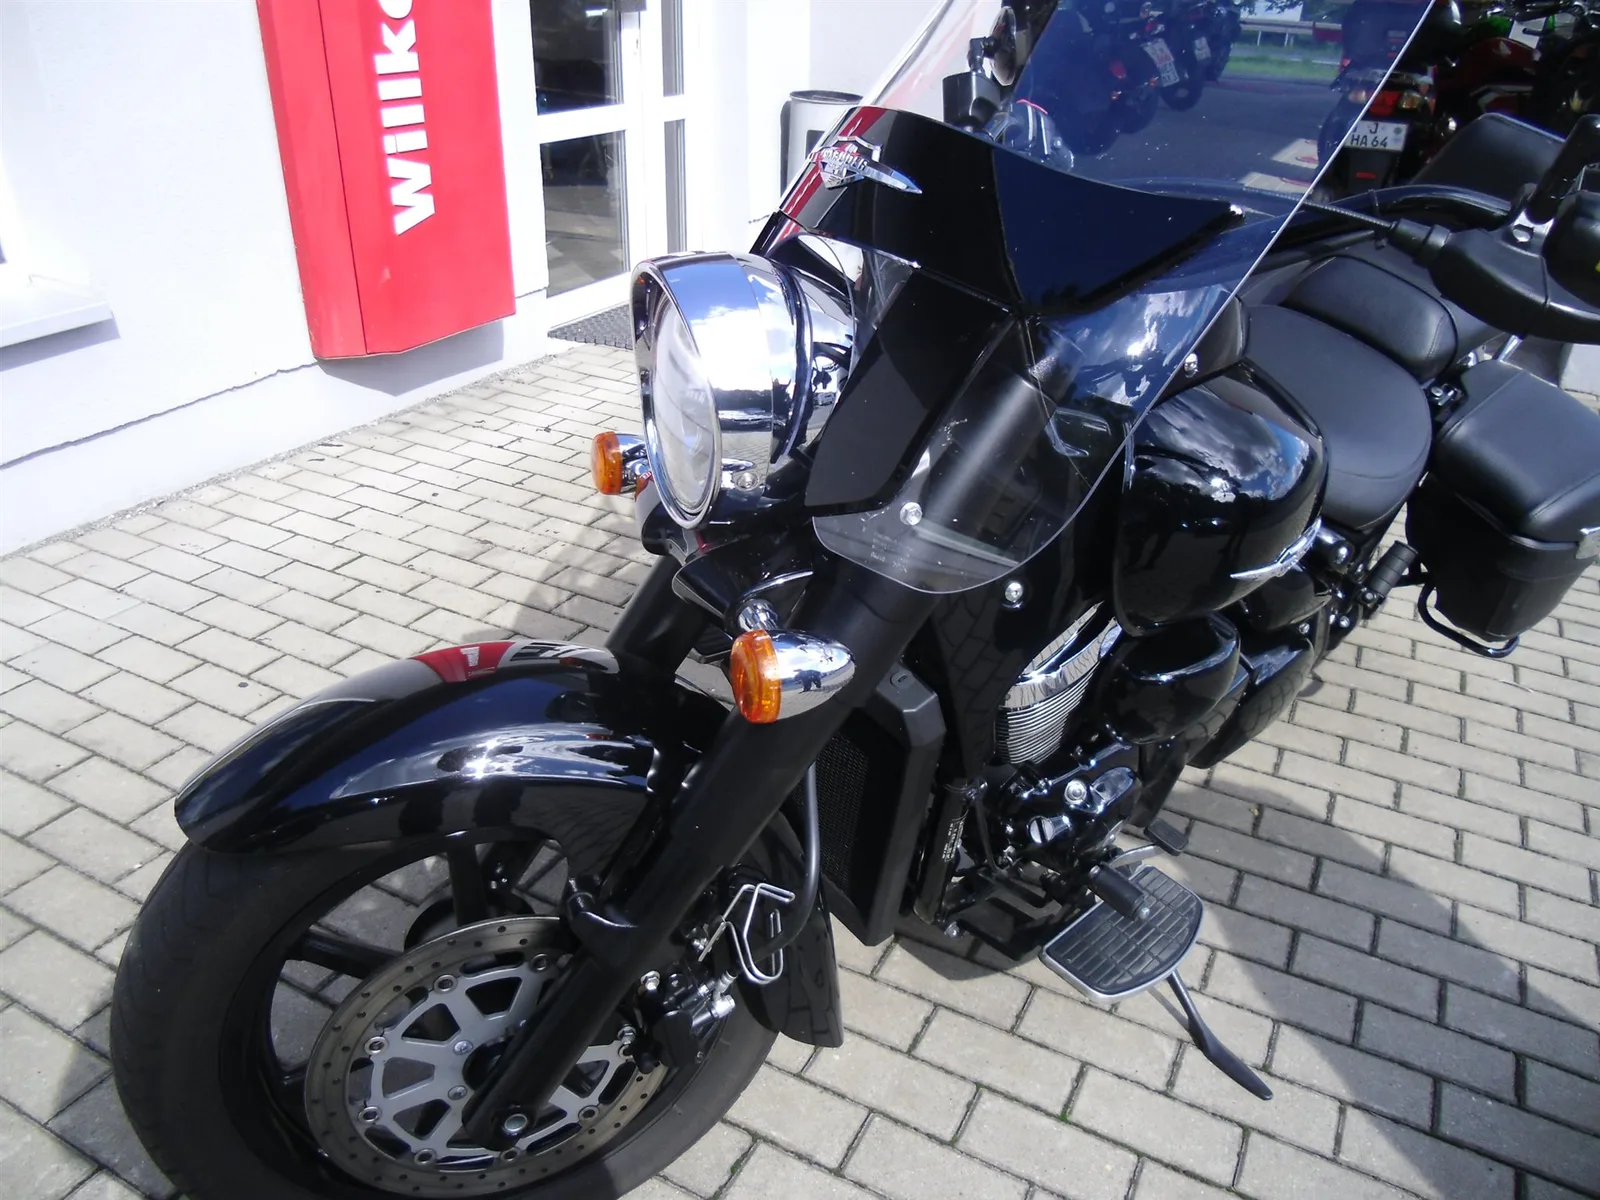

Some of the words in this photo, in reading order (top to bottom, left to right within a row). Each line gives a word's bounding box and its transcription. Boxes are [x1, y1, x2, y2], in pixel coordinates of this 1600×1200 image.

[1369, 122, 1379, 135] J
[1350, 134, 1368, 147] HA
[1371, 135, 1388, 148] 64
